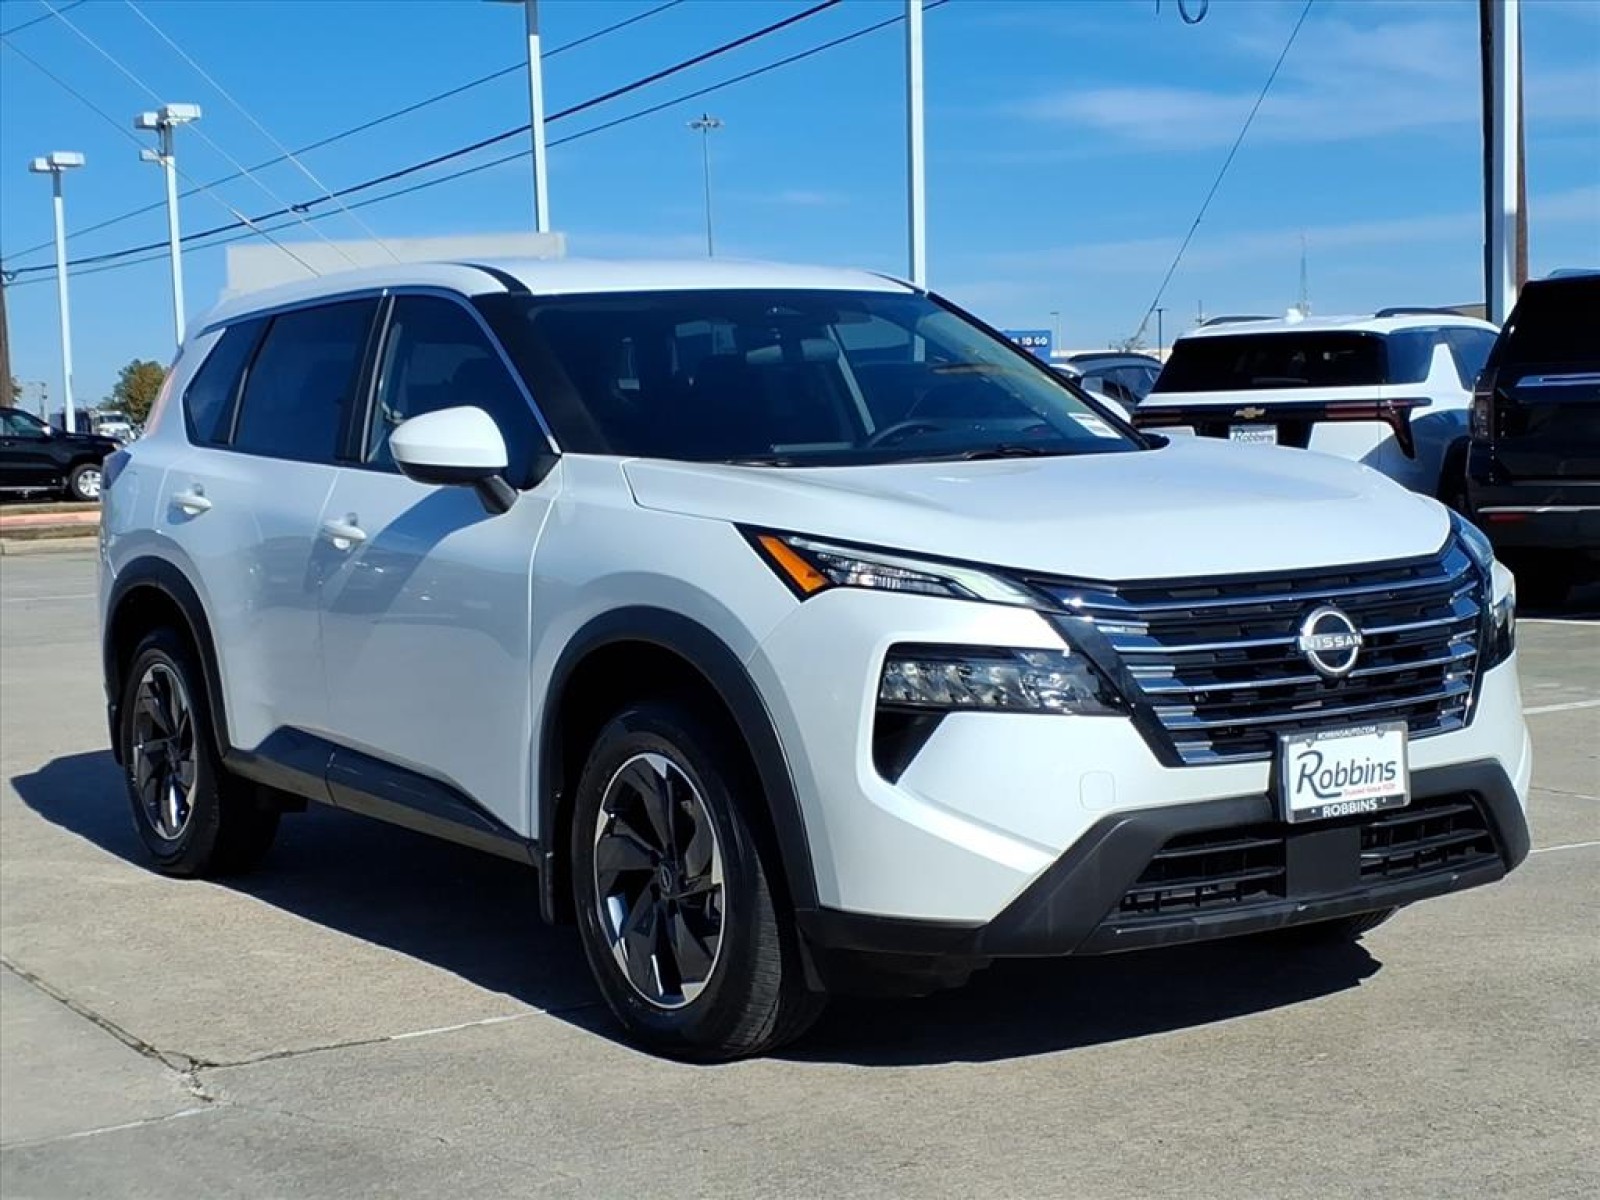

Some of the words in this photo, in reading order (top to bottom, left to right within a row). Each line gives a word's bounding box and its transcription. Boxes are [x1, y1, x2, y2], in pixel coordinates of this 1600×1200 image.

[1300, 634, 1362, 650] NISSAN
[1296, 749, 1397, 799] Robbins
[1322, 798, 1378, 818] ROBBINS
